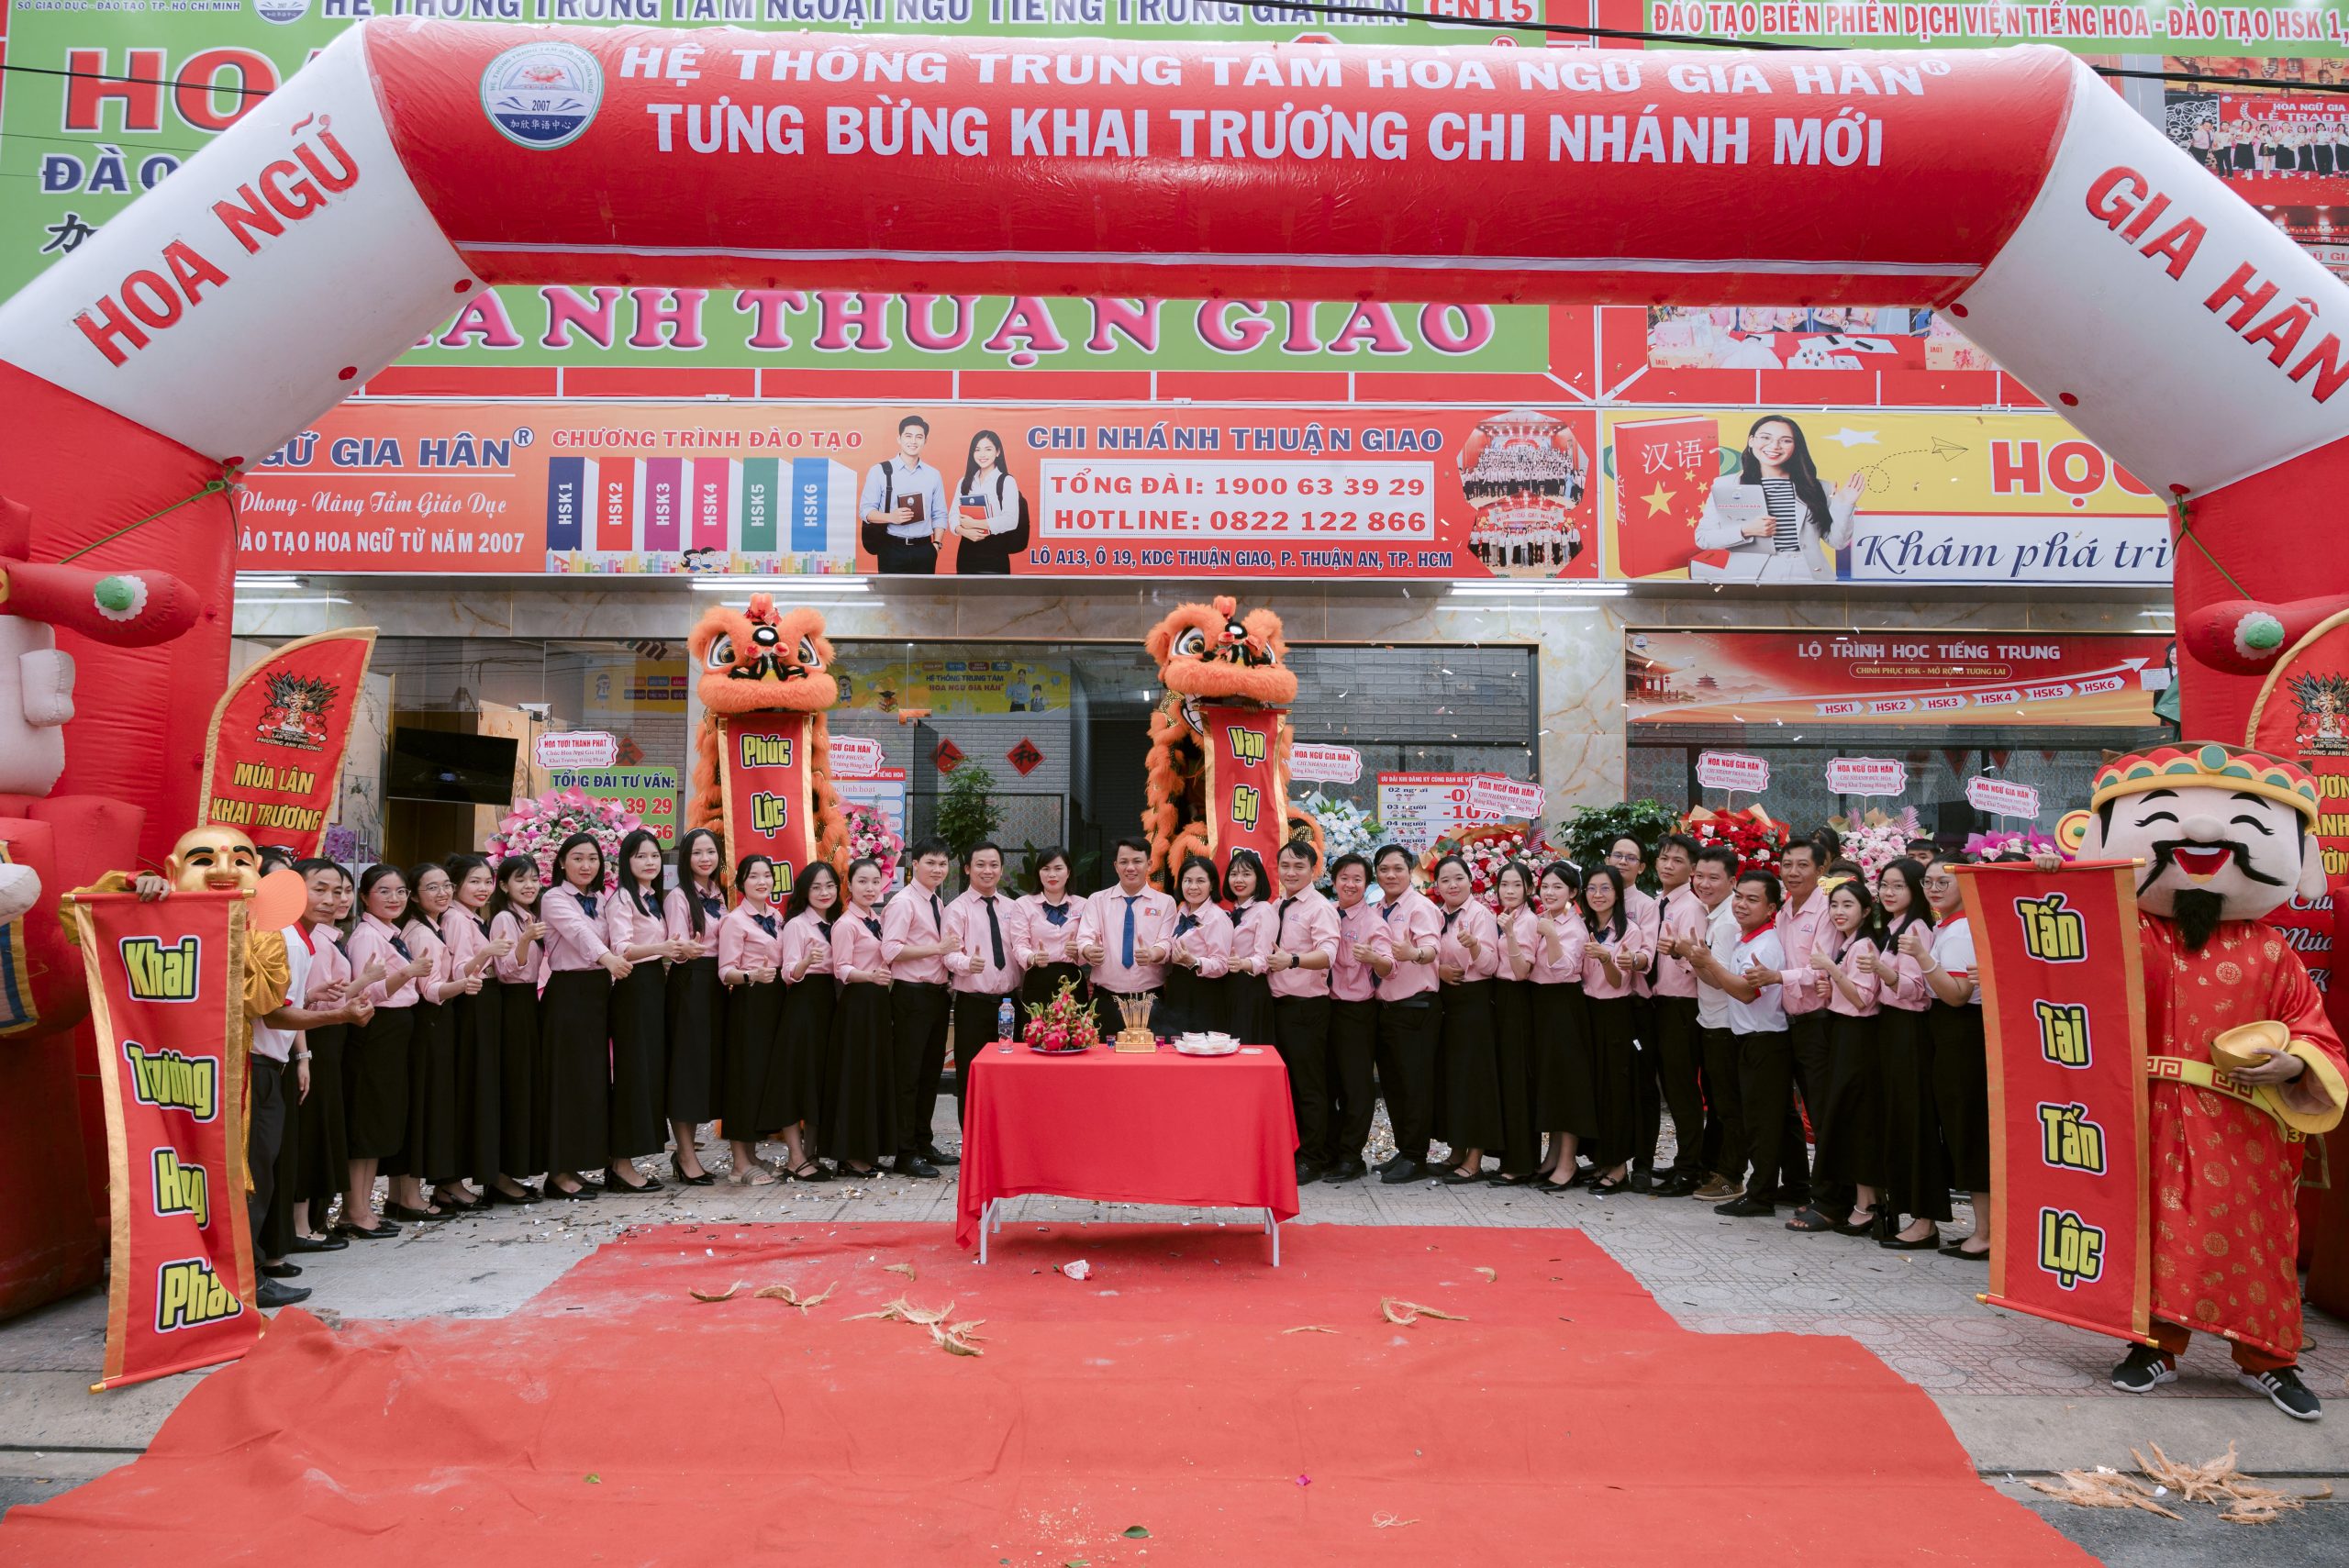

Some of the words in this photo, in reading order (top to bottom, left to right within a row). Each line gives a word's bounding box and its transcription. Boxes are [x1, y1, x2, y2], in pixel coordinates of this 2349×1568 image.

[212, 2, 240, 10] MINH
[1709, 5, 1756, 39] TẠO
[1905, 6, 1957, 39] DỊCH
[2103, 7, 2149, 36] HOA
[2169, 0, 2217, 38] ĐÀO
[2221, 10, 2269, 43] TẠO
[2277, 10, 2323, 39] HSK
[620, 45, 703, 87] HỆ
[970, 52, 1183, 86] TRUNG
[1368, 58, 1497, 90] HOA
[1667, 64, 1773, 95] GIA
[531, 99, 551, 111] 2007
[2273, 103, 2297, 111] HOA
[2326, 104, 2346, 112] GIA
[2285, 113, 2334, 122] TRAO
[509, 118, 573, 131] 加欣华语中心
[647, 96, 805, 155] TƯNG
[827, 95, 988, 158] BỪNG
[1010, 109, 1149, 158] KHAI
[1170, 102, 1409, 161] TRƯƠNG
[1428, 112, 1526, 161] CHI
[1549, 105, 1749, 163] NHÁNH
[1774, 106, 1883, 166] MỚI
[73, 239, 229, 368] HOA
[212, 112, 361, 256] NGỮ
[2085, 165, 2209, 281] GIA
[2203, 261, 2349, 405] HÂN
[1196, 301, 1495, 353] GIAO
[331, 438, 404, 467] GIA
[551, 428, 657, 449] CHƯƠNG
[663, 428, 741, 449] TRÌNH
[748, 428, 804, 449] ĐÀO
[809, 429, 863, 451] TẠO
[1026, 426, 1086, 450] CHI
[1098, 422, 1220, 450] NHÁNH
[1229, 423, 1353, 457] THUẬN
[1360, 428, 1444, 453] GIAO
[1051, 467, 1132, 496] TỔNG
[1140, 473, 1204, 496] ĐÀI:
[1214, 476, 1287, 496] 1900
[1297, 476, 1335, 496] 63
[1342, 476, 1381, 496] 39
[1388, 476, 1425, 497] 29
[312, 491, 365, 517] Nâng
[370, 490, 413, 514] Tầm
[415, 492, 463, 518] Giáo
[467, 492, 507, 519] Dục
[557, 482, 573, 526] HSK1
[607, 482, 624, 527] HSK2
[655, 482, 672, 527] HSK3
[703, 482, 718, 527] HSK4
[750, 483, 765, 528] HSK5
[803, 483, 818, 528] HSK6
[1054, 509, 1201, 531] HOTLINE:
[1209, 509, 1289, 532] 0822
[1300, 510, 1359, 532] 122
[1367, 510, 1427, 532] 866
[239, 526, 268, 552] ÀO
[273, 530, 310, 556] TẠO
[316, 531, 351, 552] HOA
[357, 526, 395, 553] NGỮ
[400, 527, 427, 552] TỪ
[431, 528, 473, 553] NĂM
[478, 533, 526, 553] 2007
[1856, 529, 2009, 577] Khám
[2010, 531, 2106, 578] phá
[1030, 548, 1051, 566] LÔ
[1055, 550, 1091, 568] A13,
[1096, 547, 1107, 566] Ô
[1112, 550, 1136, 568] 19,
[1141, 550, 1174, 566] KDC
[1178, 547, 1231, 569] THUẬN
[1234, 550, 1276, 568] GIAO,
[1280, 551, 1297, 567] P.
[1301, 548, 1353, 570] THUẬN
[1357, 551, 1383, 569] AN,
[1387, 551, 1413, 567] TP.
[1418, 551, 1453, 567] HCM
[1798, 641, 1822, 661] LỘ
[1830, 642, 1886, 658] TRÌNH
[1892, 644, 1930, 661] HỌC
[1937, 641, 1989, 659] TIẾNG
[1997, 645, 2061, 660] TRUNG
[1993, 668, 2006, 676] LAI
[2084, 681, 2115, 693] HSK6
[1825, 704, 1854, 713] HSK1
[1876, 701, 1907, 712] HSK2
[1928, 697, 1958, 709] HSK3
[1981, 693, 2012, 704] HSK4
[2032, 687, 2064, 698] HSK5
[741, 736, 793, 767] Phúc
[1013, 744, 1041, 766] 和
[1228, 727, 1266, 766] Vạn
[233, 761, 274, 790] MÚA
[278, 766, 315, 795] LÂN
[552, 769, 590, 787] TỔNG
[594, 773, 617, 788] ĐÀI
[621, 773, 641, 788] TƯ
[643, 770, 675, 788] VẤN:
[1837, 764, 1851, 773] HOA
[211, 797, 255, 826] KHAI
[255, 802, 323, 831] TRƯƠNG
[625, 797, 646, 815] 39
[651, 797, 673, 815] 29
[752, 792, 786, 838] Lộc
[1232, 784, 1260, 831] Sự
[2016, 892, 2087, 962] Tấn
[121, 935, 199, 1002] Khai
[2035, 999, 2092, 1069] Tài
[125, 1040, 218, 1122] Trương
[2038, 1103, 2107, 1174] Tấn
[2039, 1207, 2106, 1290] Lộc
